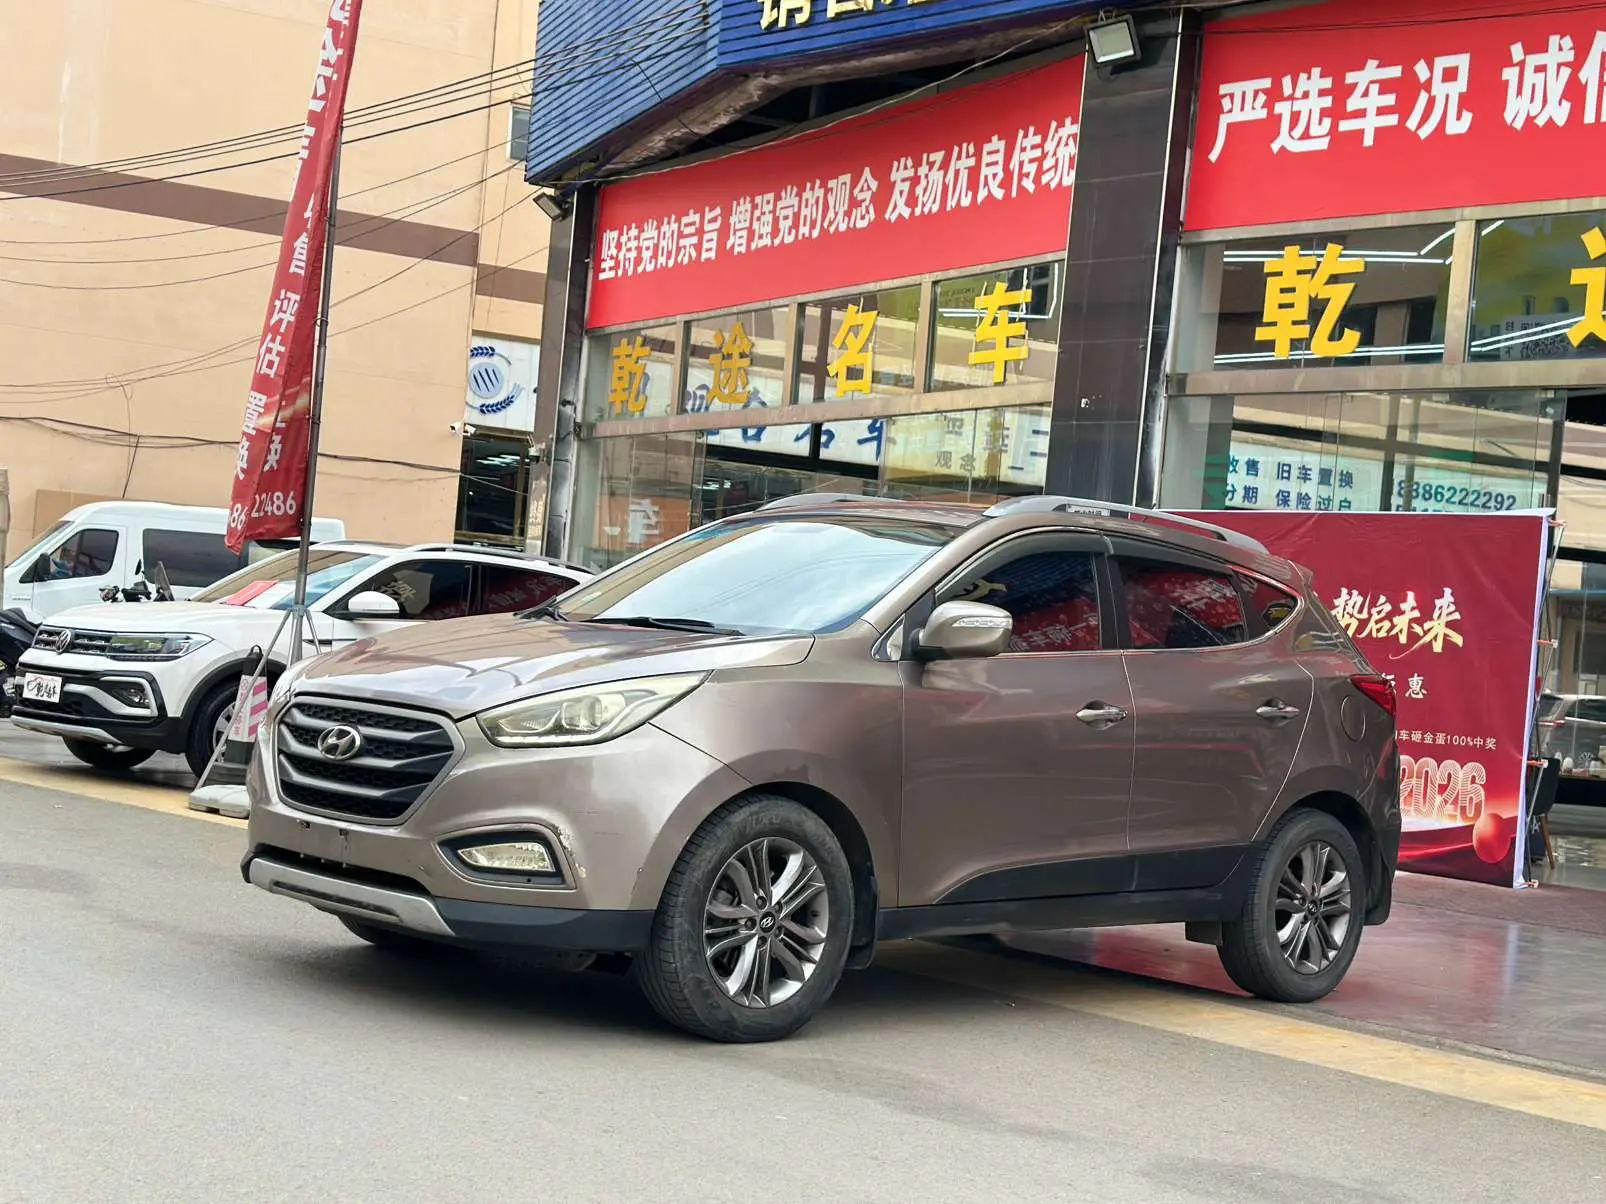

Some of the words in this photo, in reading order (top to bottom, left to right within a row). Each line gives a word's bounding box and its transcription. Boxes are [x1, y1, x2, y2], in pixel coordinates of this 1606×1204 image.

[1207, 52, 1474, 163] 严选车况
[597, 206, 726, 281] 坚持党的宗旨
[726, 165, 879, 256] 增强党的观念
[884, 119, 1078, 222] 发扬优良传统
[257, 289, 300, 378] 评估
[1276, 461, 1354, 490] 旧车置换
[1395, 729, 1498, 751] 车砸金蛋100%中奖
[1400, 754, 1487, 822] 2026
